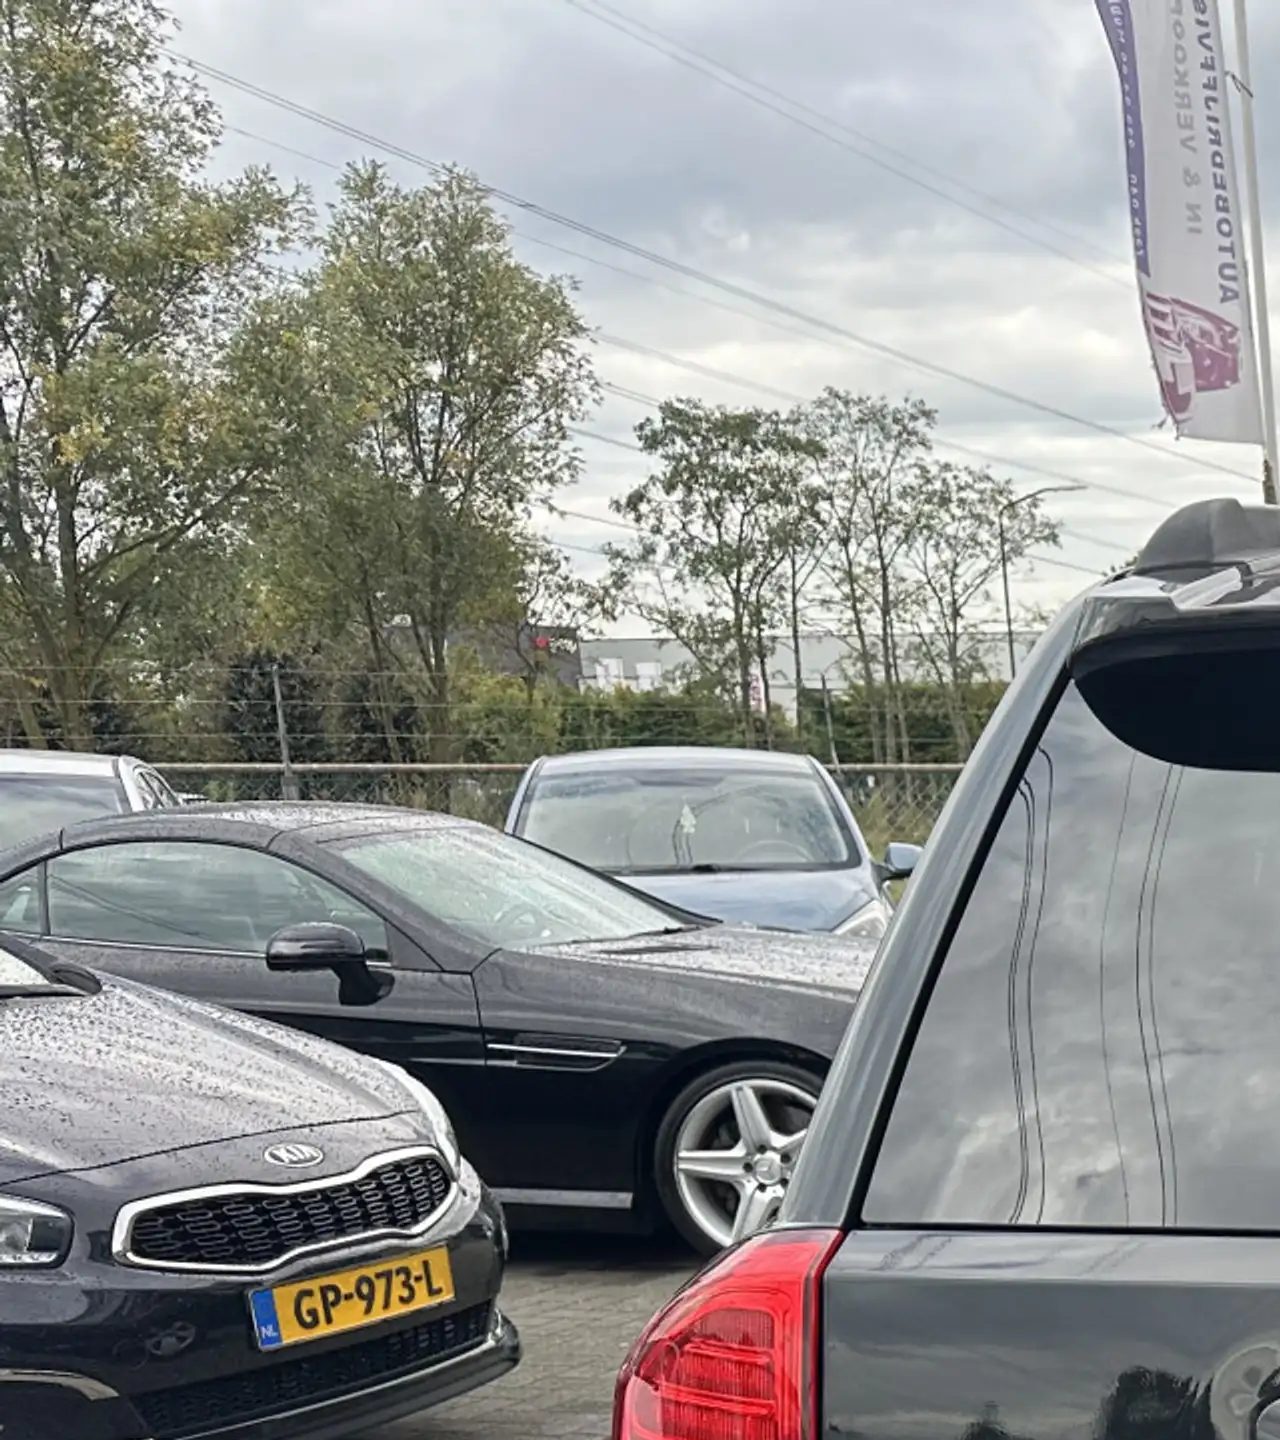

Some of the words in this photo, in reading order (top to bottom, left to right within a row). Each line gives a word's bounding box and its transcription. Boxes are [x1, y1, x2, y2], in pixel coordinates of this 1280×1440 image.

[273, 1144, 321, 1164] KIA
[260, 1323, 278, 1340] NL
[293, 1259, 444, 1330] GP-973-L
